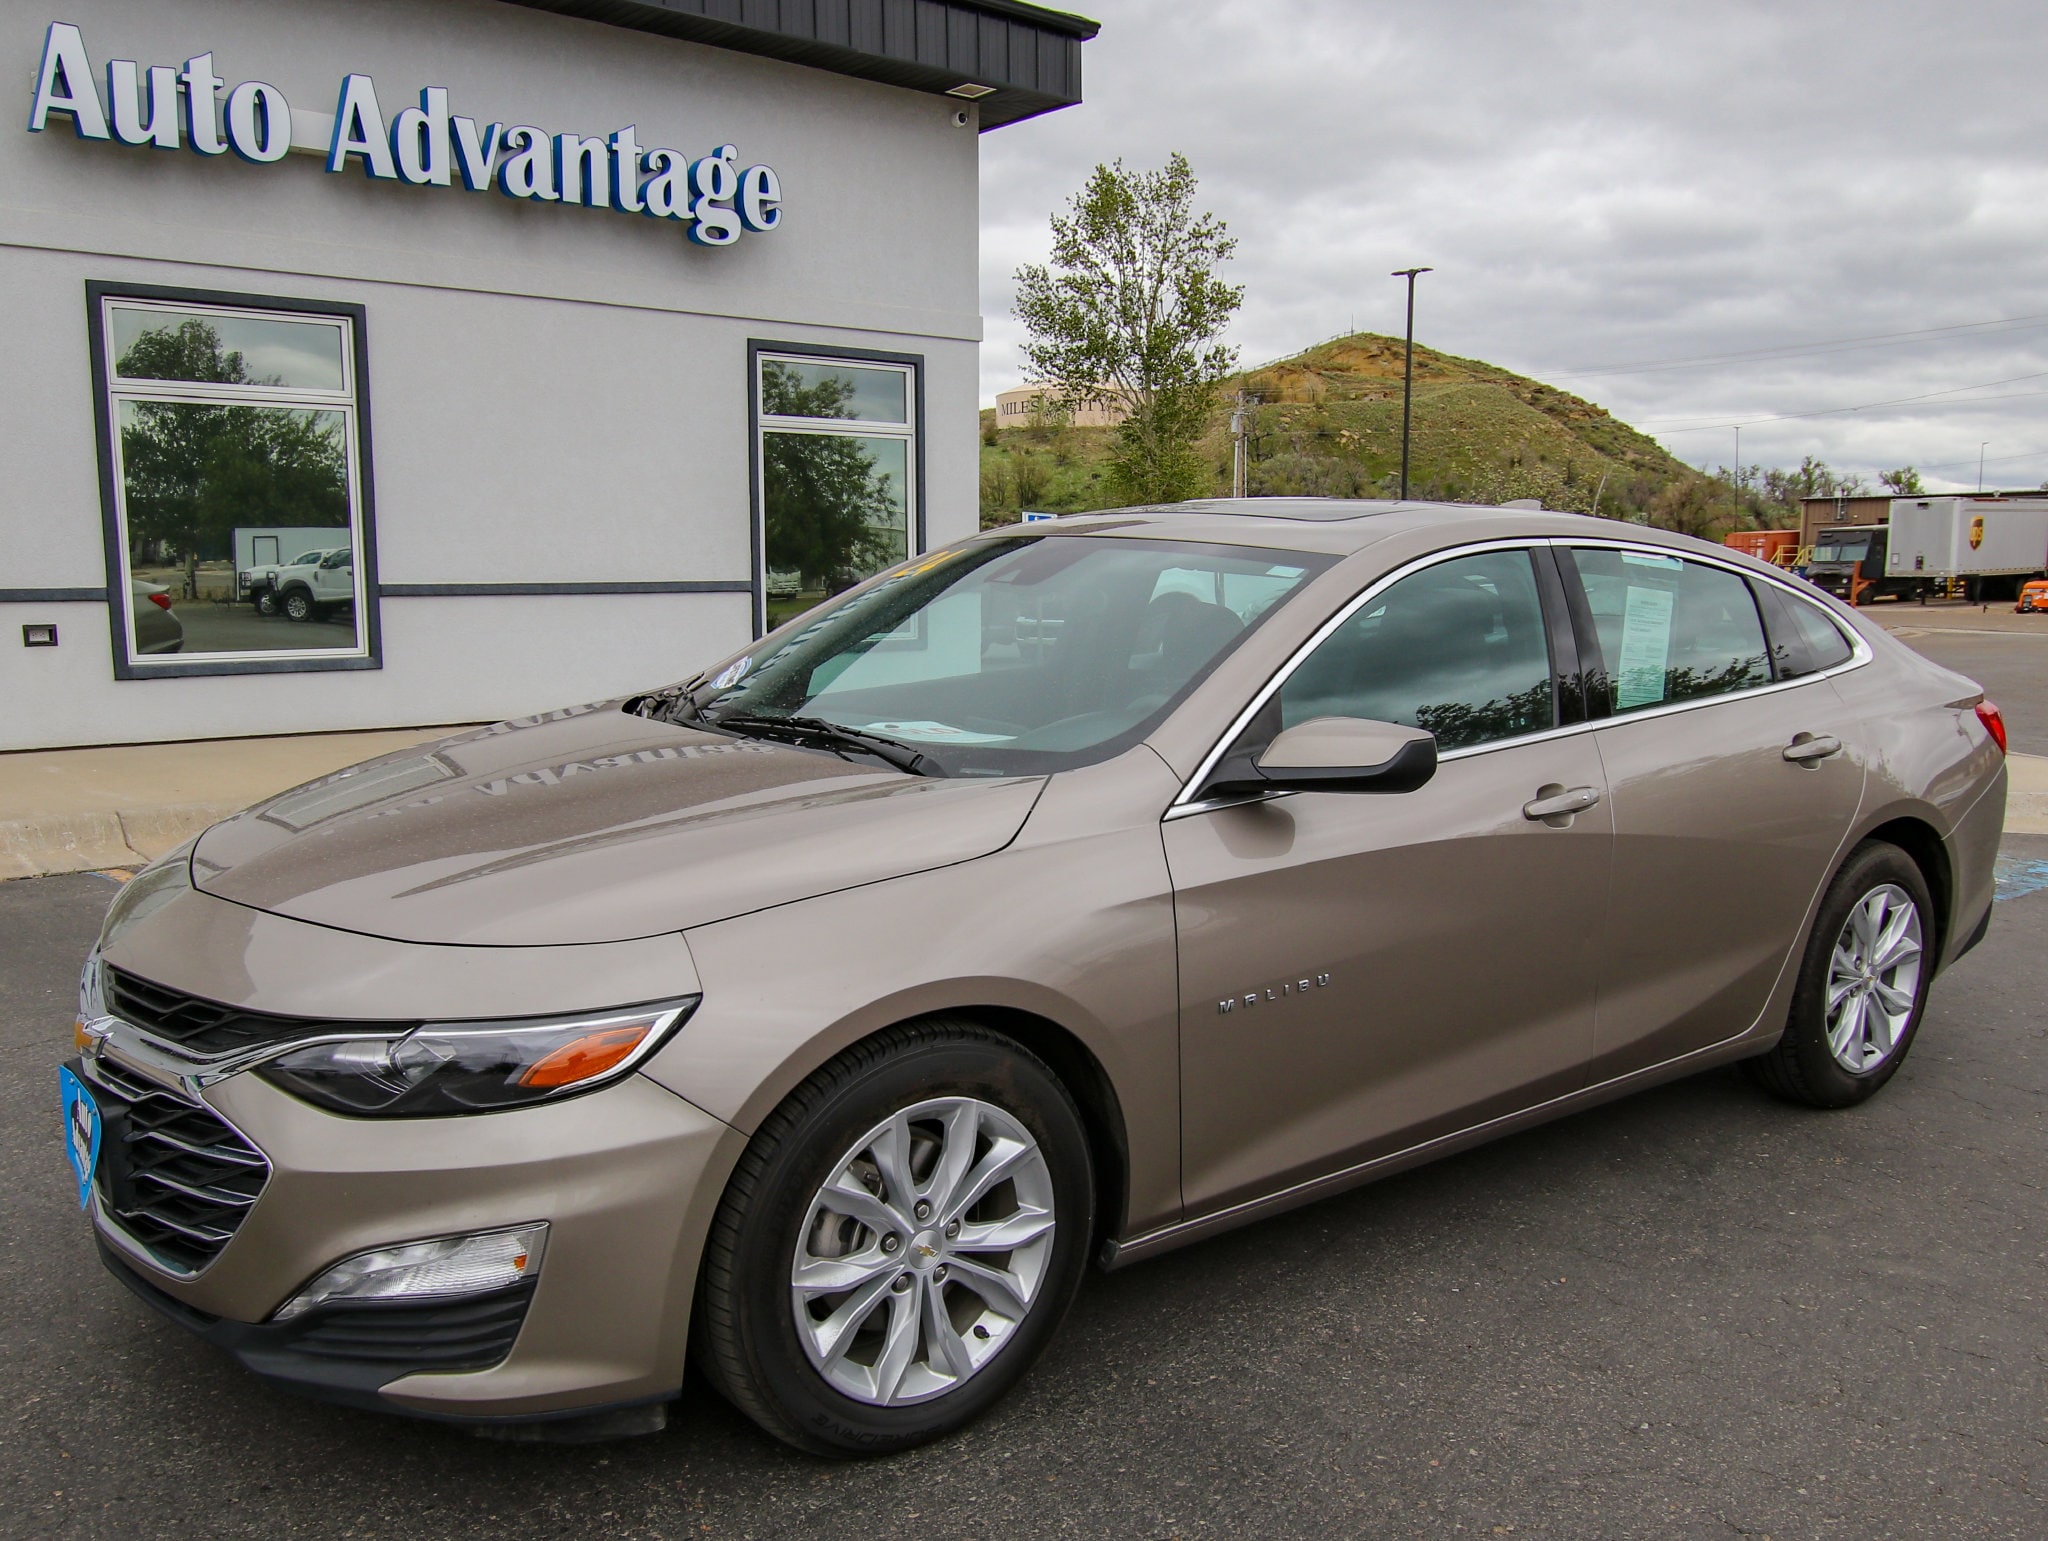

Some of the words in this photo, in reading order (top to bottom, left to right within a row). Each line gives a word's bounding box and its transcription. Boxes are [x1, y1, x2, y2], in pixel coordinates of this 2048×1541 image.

[27, 21, 292, 164] Auto
[325, 73, 783, 247] Advantage
[1218, 973, 1330, 1015] MALIBU
